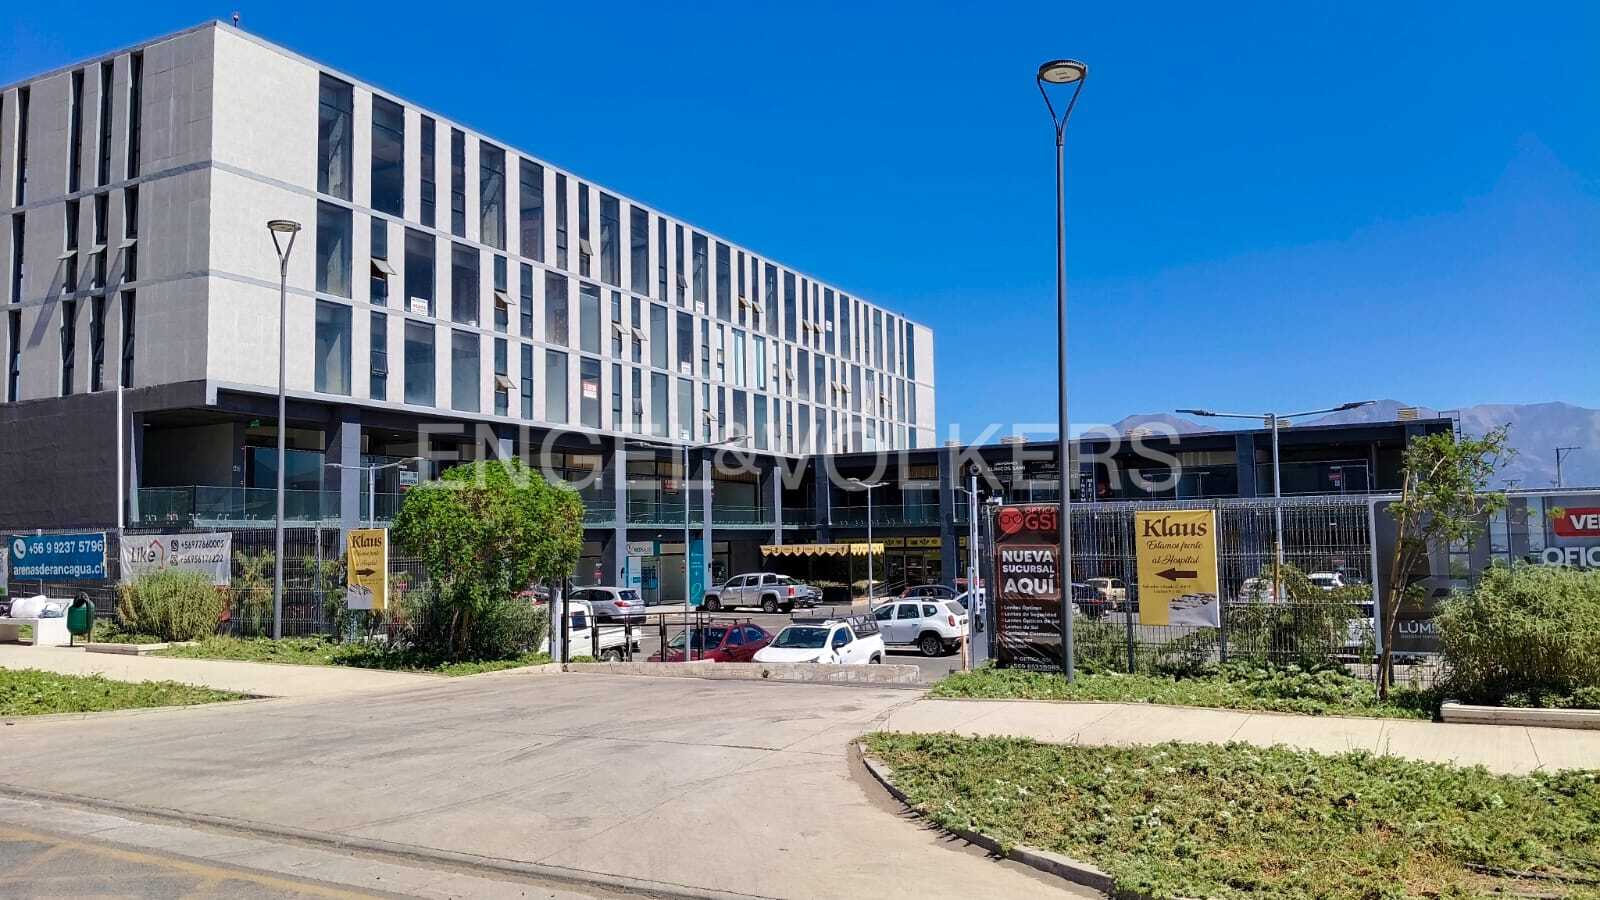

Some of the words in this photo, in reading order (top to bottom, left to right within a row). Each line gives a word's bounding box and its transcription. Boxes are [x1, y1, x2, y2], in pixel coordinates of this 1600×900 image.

[1024, 513, 1057, 530] GSI
[1142, 515, 1208, 538] Klaus
[1569, 513, 1600, 530] VE
[29, 542, 44, 554] +56
[46, 541, 52, 553] 9
[54, 540, 76, 553] 9237
[78, 539, 103, 553] 5796
[351, 533, 382, 548] Klaus
[131, 546, 156, 563] Like
[1002, 550, 1054, 563] NUEVA
[13, 561, 103, 577] arenasderancagua.cl
[1002, 564, 1055, 573] SUCURSAL
[1004, 574, 1054, 595] AQUÍ
